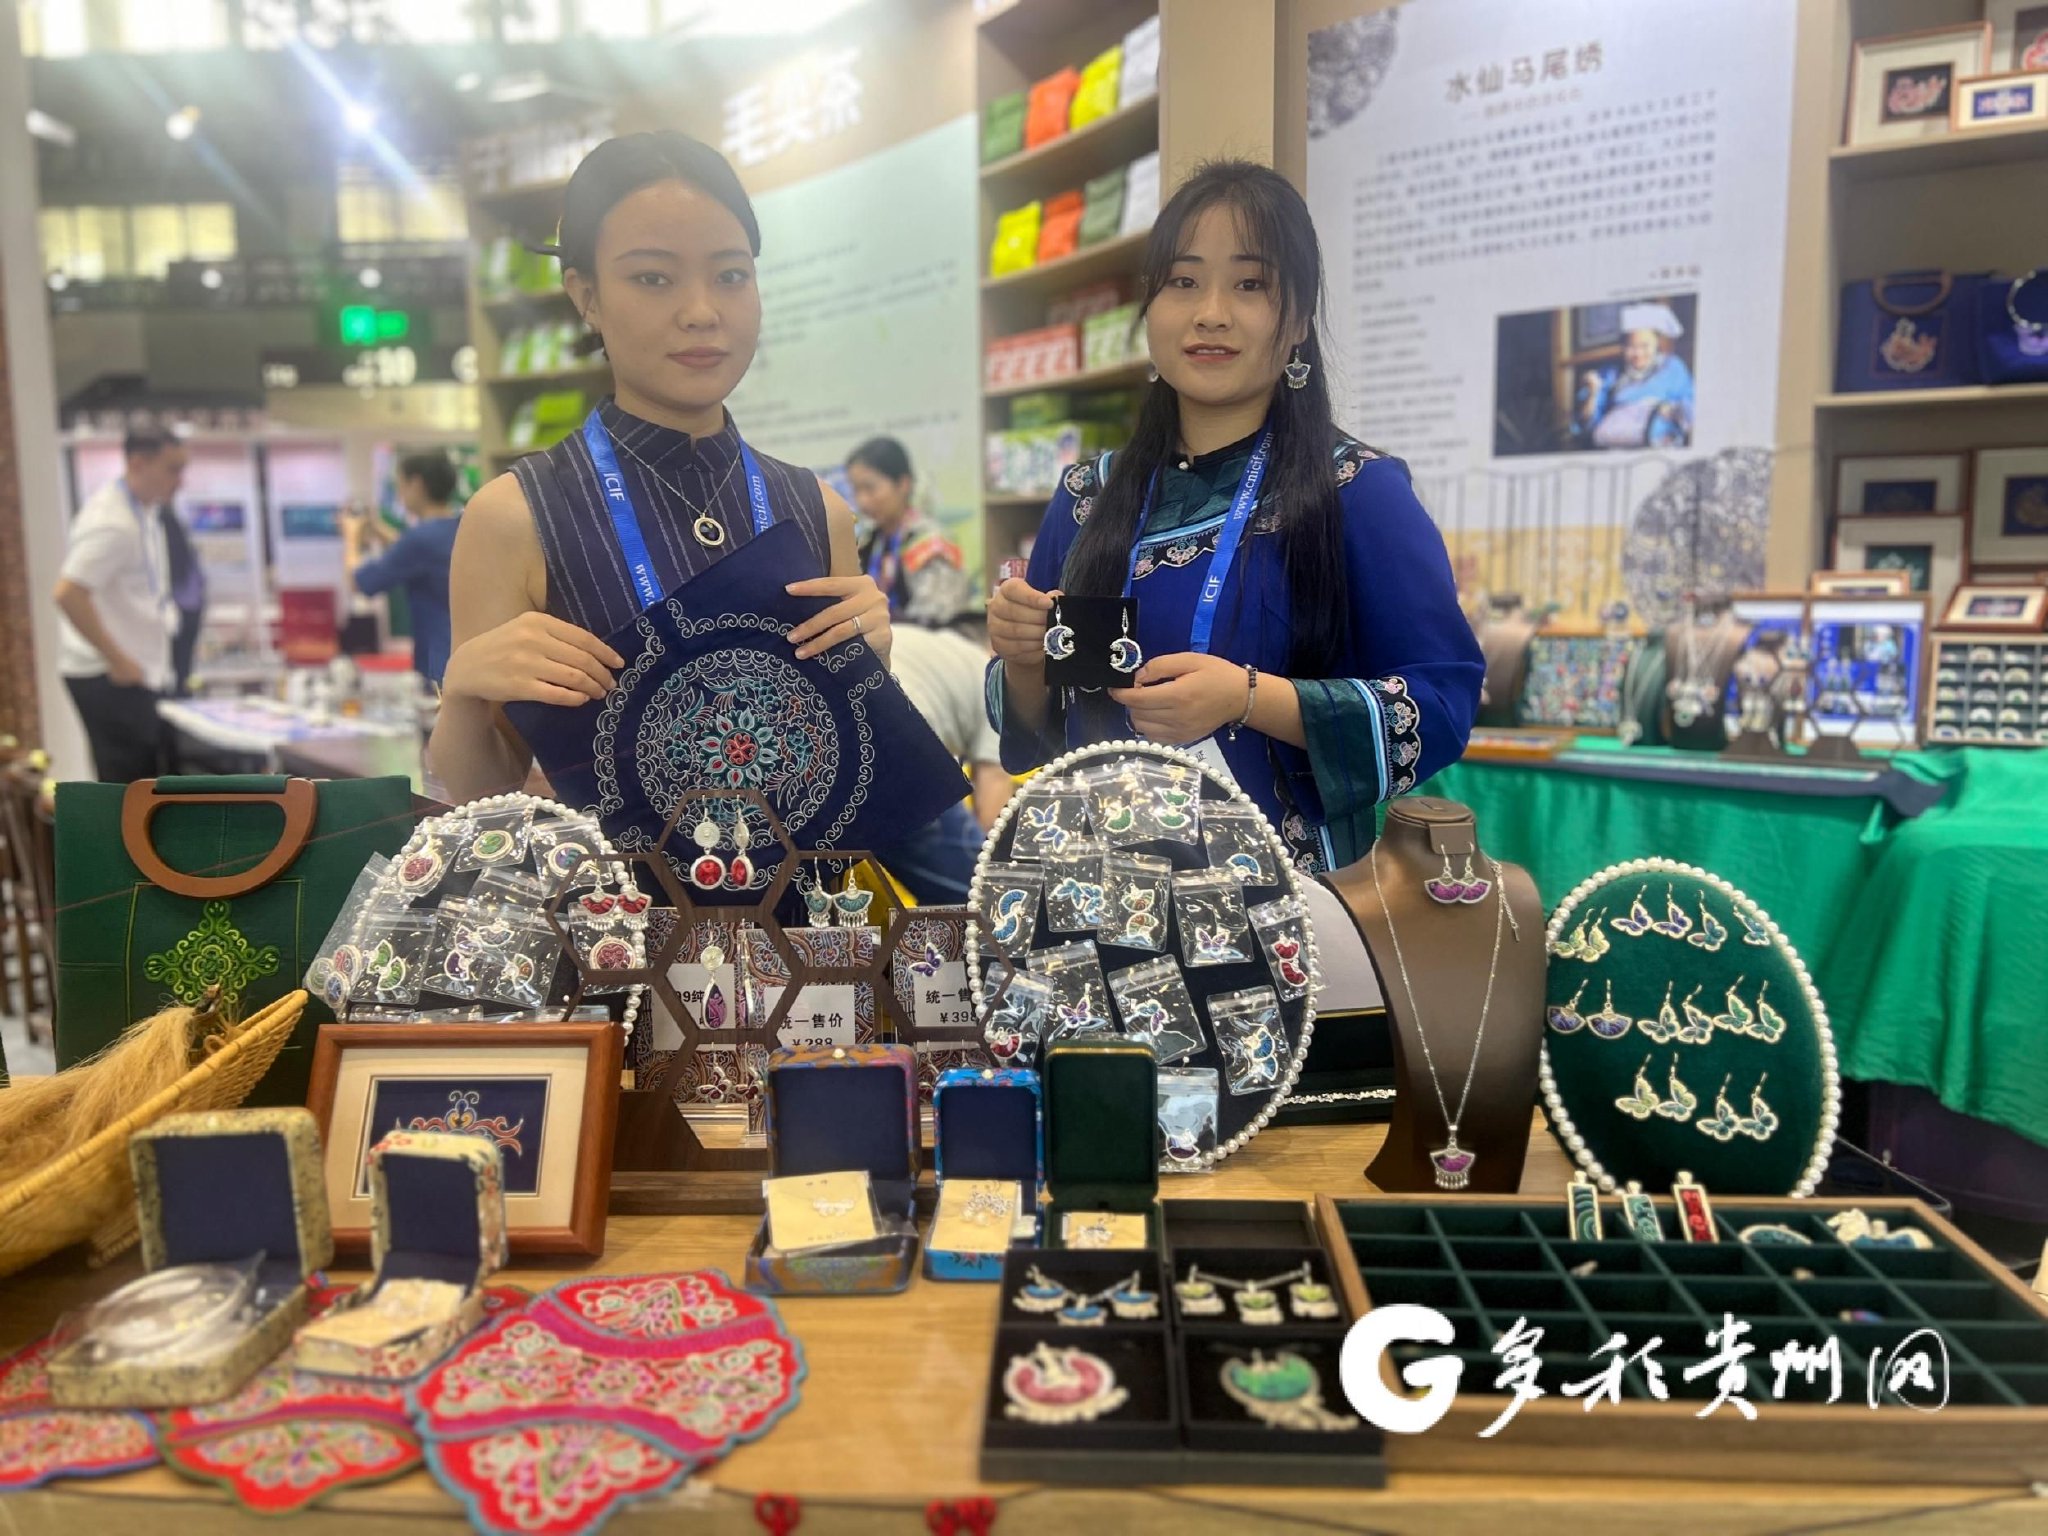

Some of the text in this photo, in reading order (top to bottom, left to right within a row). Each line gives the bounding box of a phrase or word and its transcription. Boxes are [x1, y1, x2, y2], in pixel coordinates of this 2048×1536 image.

[602, 472, 625, 502] ICIF
[1233, 432, 1275, 521] www.cnicif.com
[1202, 574, 1222, 603] ICIF
